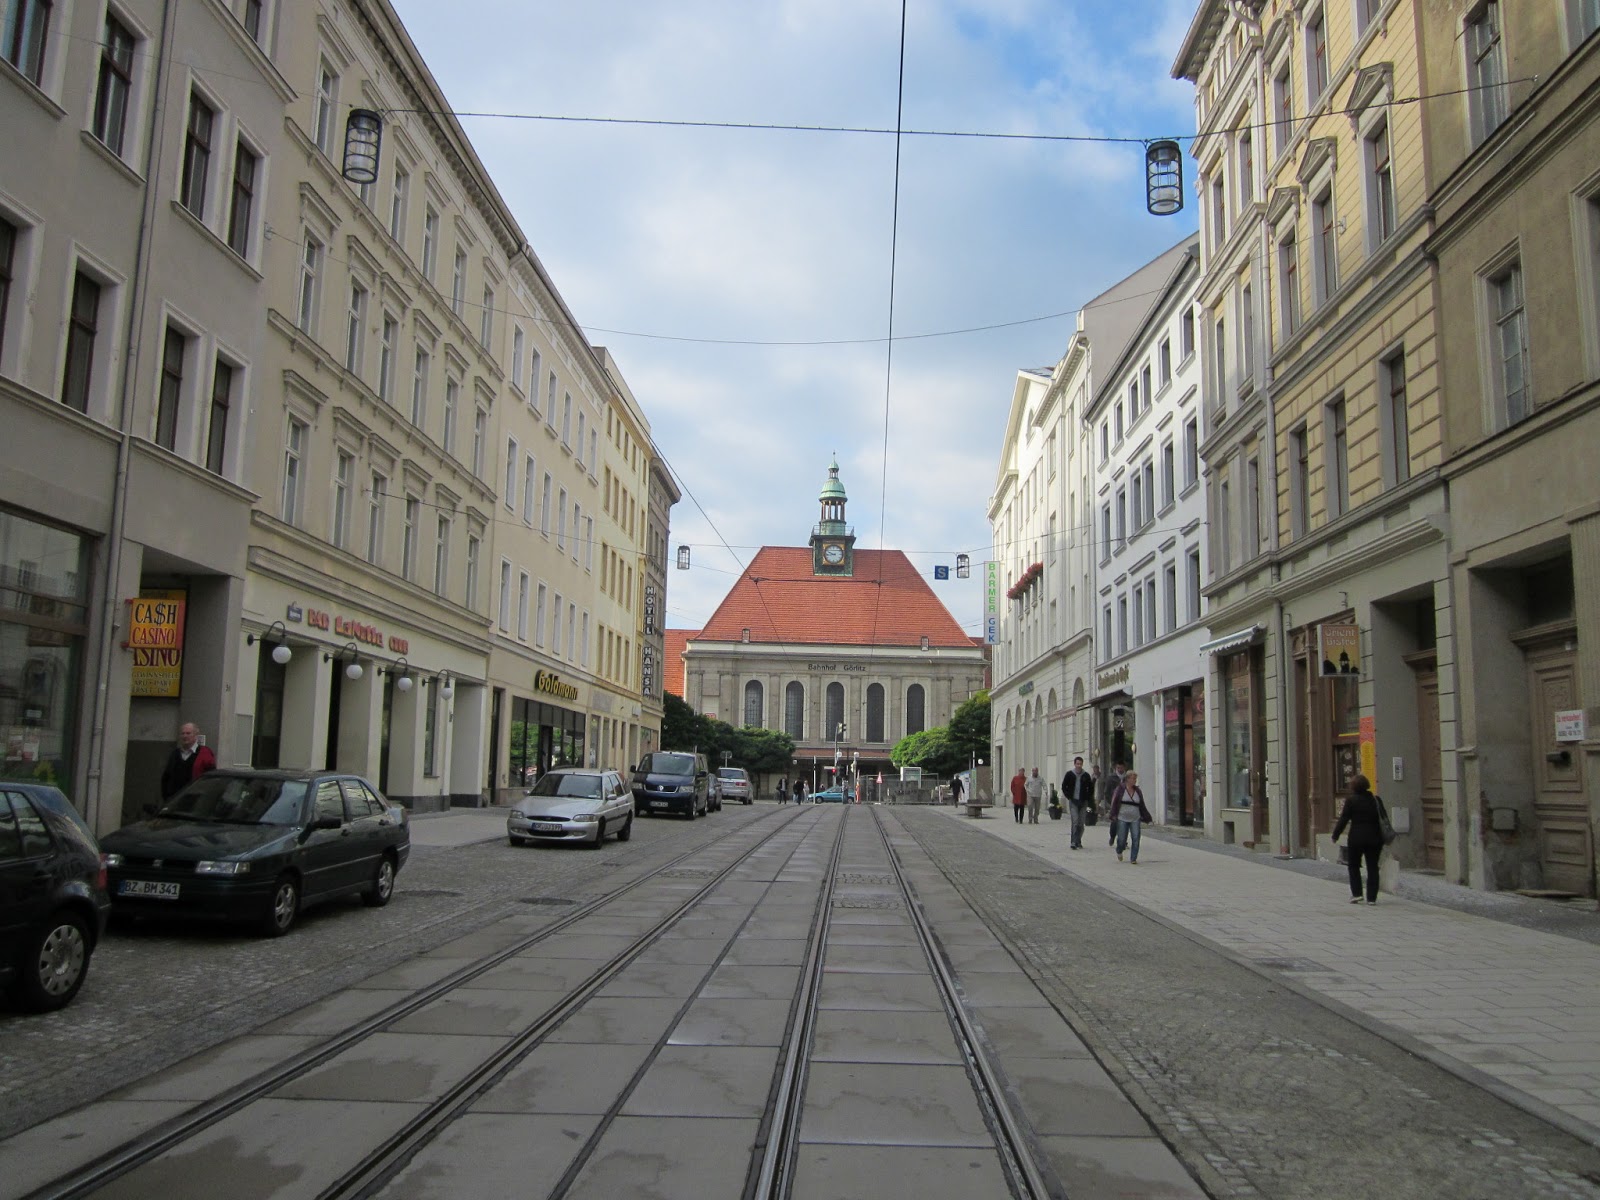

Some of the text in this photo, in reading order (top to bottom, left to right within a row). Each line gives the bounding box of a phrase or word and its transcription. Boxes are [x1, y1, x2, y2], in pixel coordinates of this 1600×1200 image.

[937, 567, 947, 578] S
[988, 562, 996, 642] BARMER GEK
[135, 602, 177, 626] CA$H
[132, 627, 175, 645] CASINO
[643, 587, 654, 695] HOTEL HANSA
[808, 663, 836, 671] Bahnhof
[537, 670, 578, 700] Goldmann
[125, 881, 178, 895] BZ BM 341
